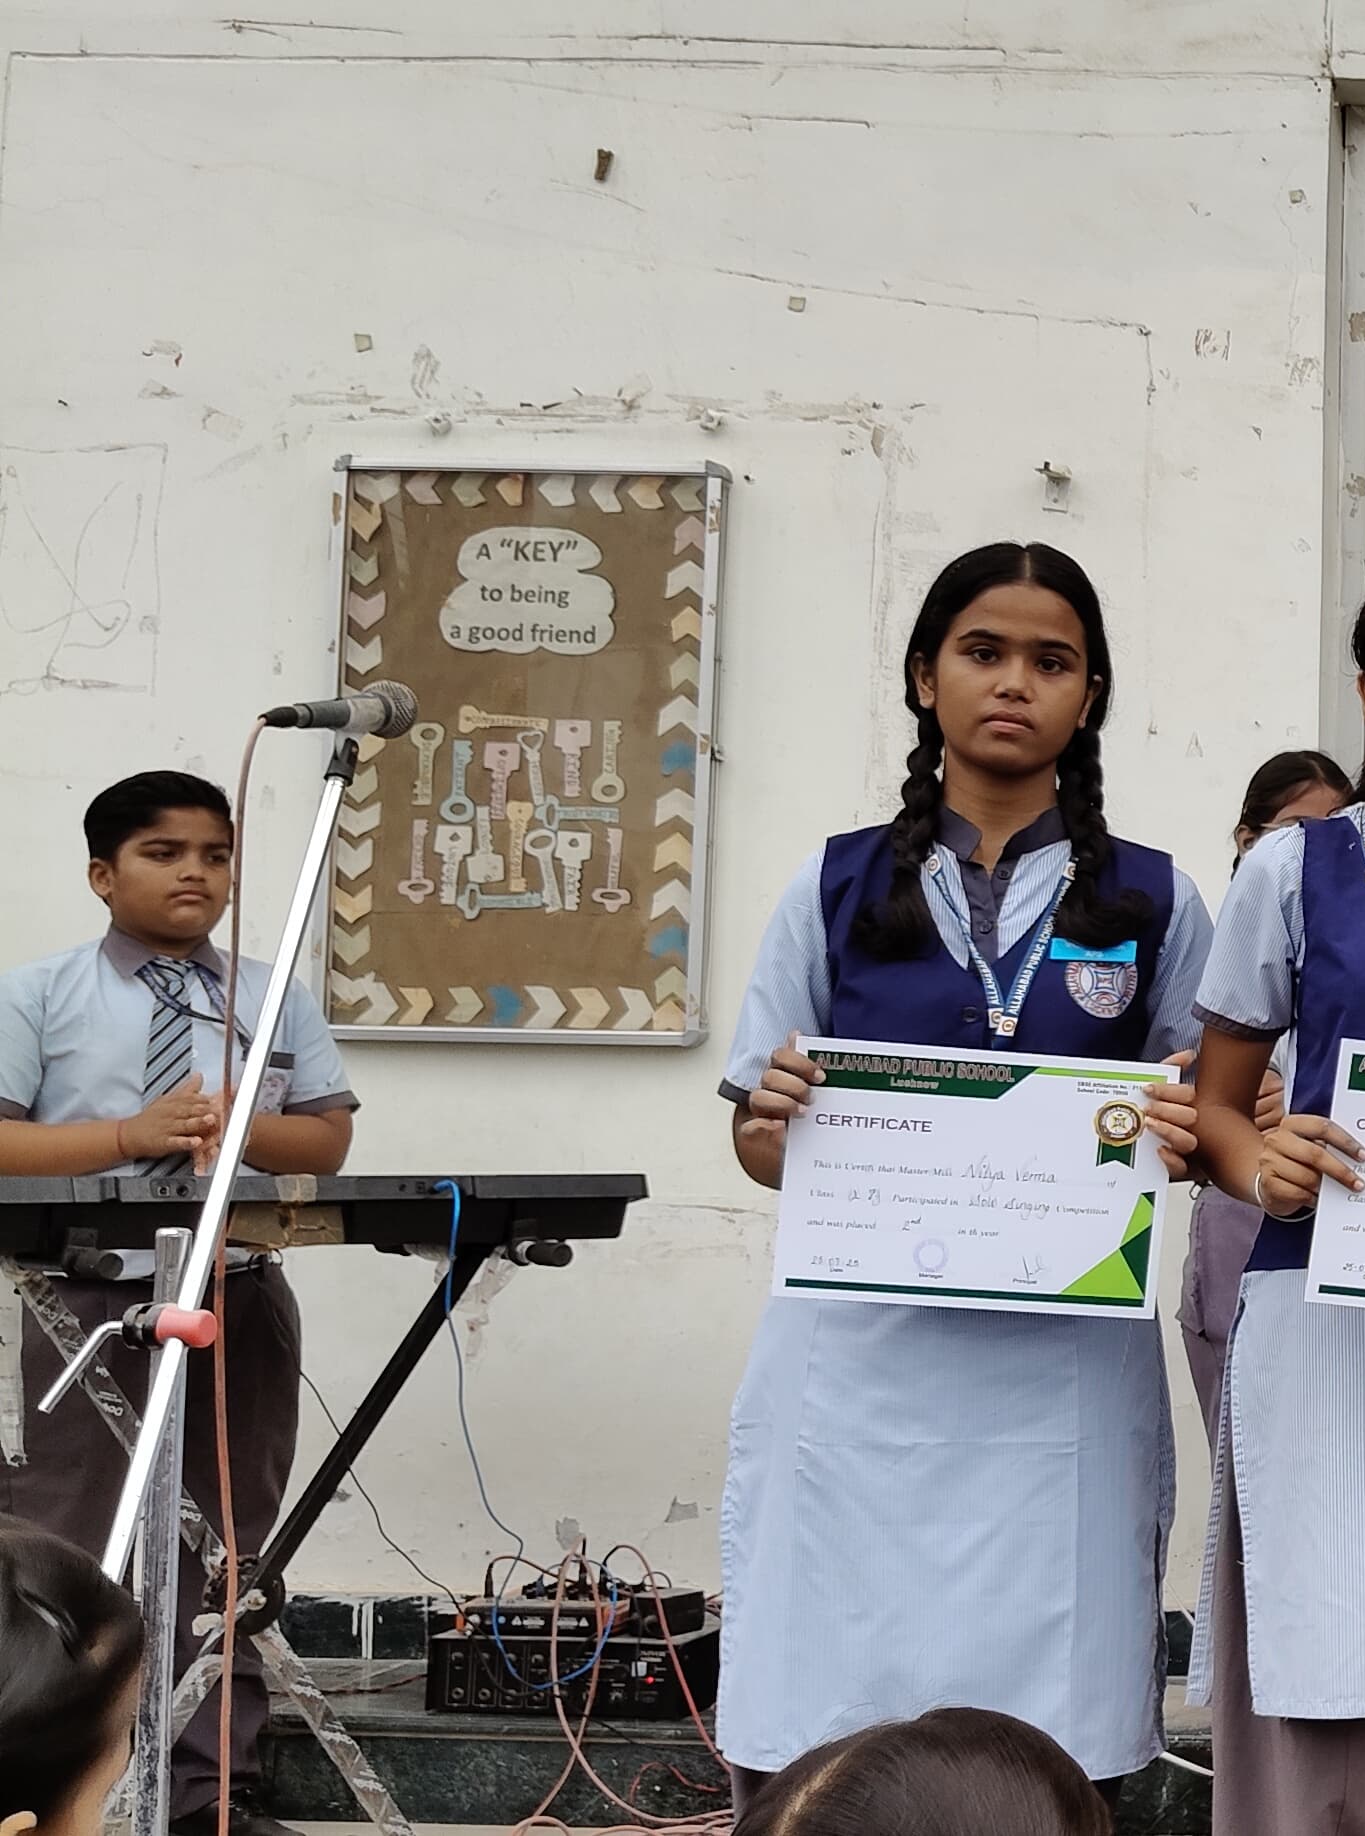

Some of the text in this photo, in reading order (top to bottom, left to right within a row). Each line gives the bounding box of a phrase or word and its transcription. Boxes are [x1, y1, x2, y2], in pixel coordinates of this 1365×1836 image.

[476, 538, 578, 562] A “KEY”
[480, 584, 570, 608] to being
[450, 622, 596, 644] a good friend
[1008, 943, 1046, 1017] ALLAHABAD PUBLIC
[814, 1051, 1017, 1083] ALLAHABAD PUBLIC SCHOOL
[814, 1112, 933, 1133] CERTIFICATE
[949, 1197, 958, 1206] in
[1342, 1222, 1360, 1233] and
